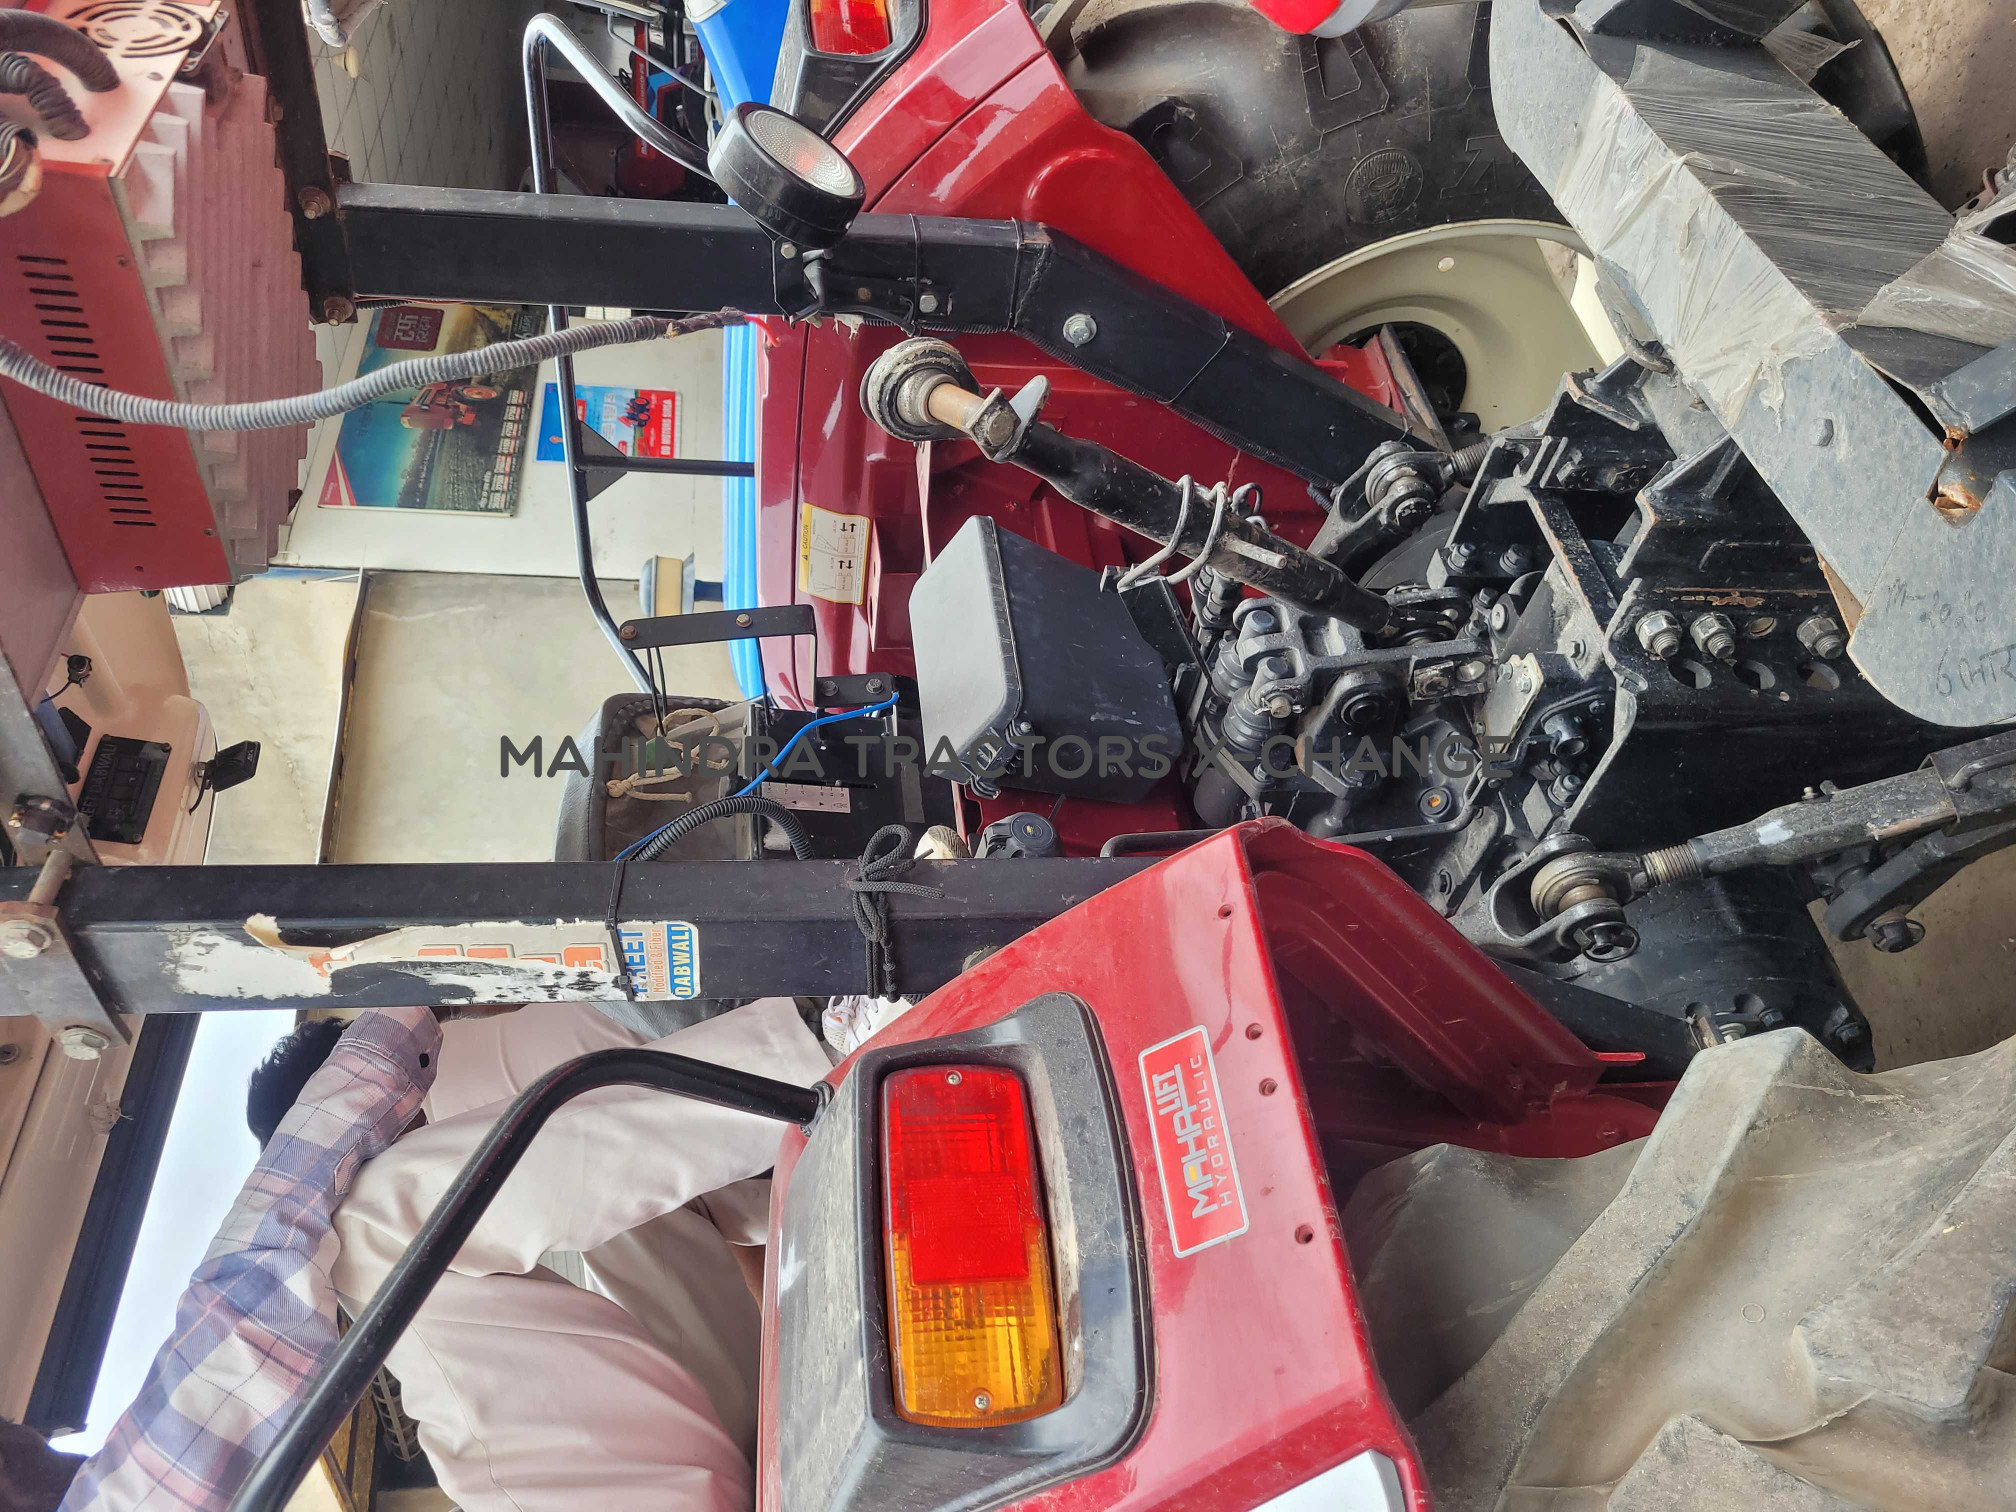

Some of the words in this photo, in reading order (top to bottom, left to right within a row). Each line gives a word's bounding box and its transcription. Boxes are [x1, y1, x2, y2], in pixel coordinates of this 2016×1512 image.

[649, 928, 663, 950] Fiber
[671, 926, 692, 996] DABWALI
[649, 960, 666, 993] Modified
[1189, 1054, 1233, 1208] HYDRAULIC
